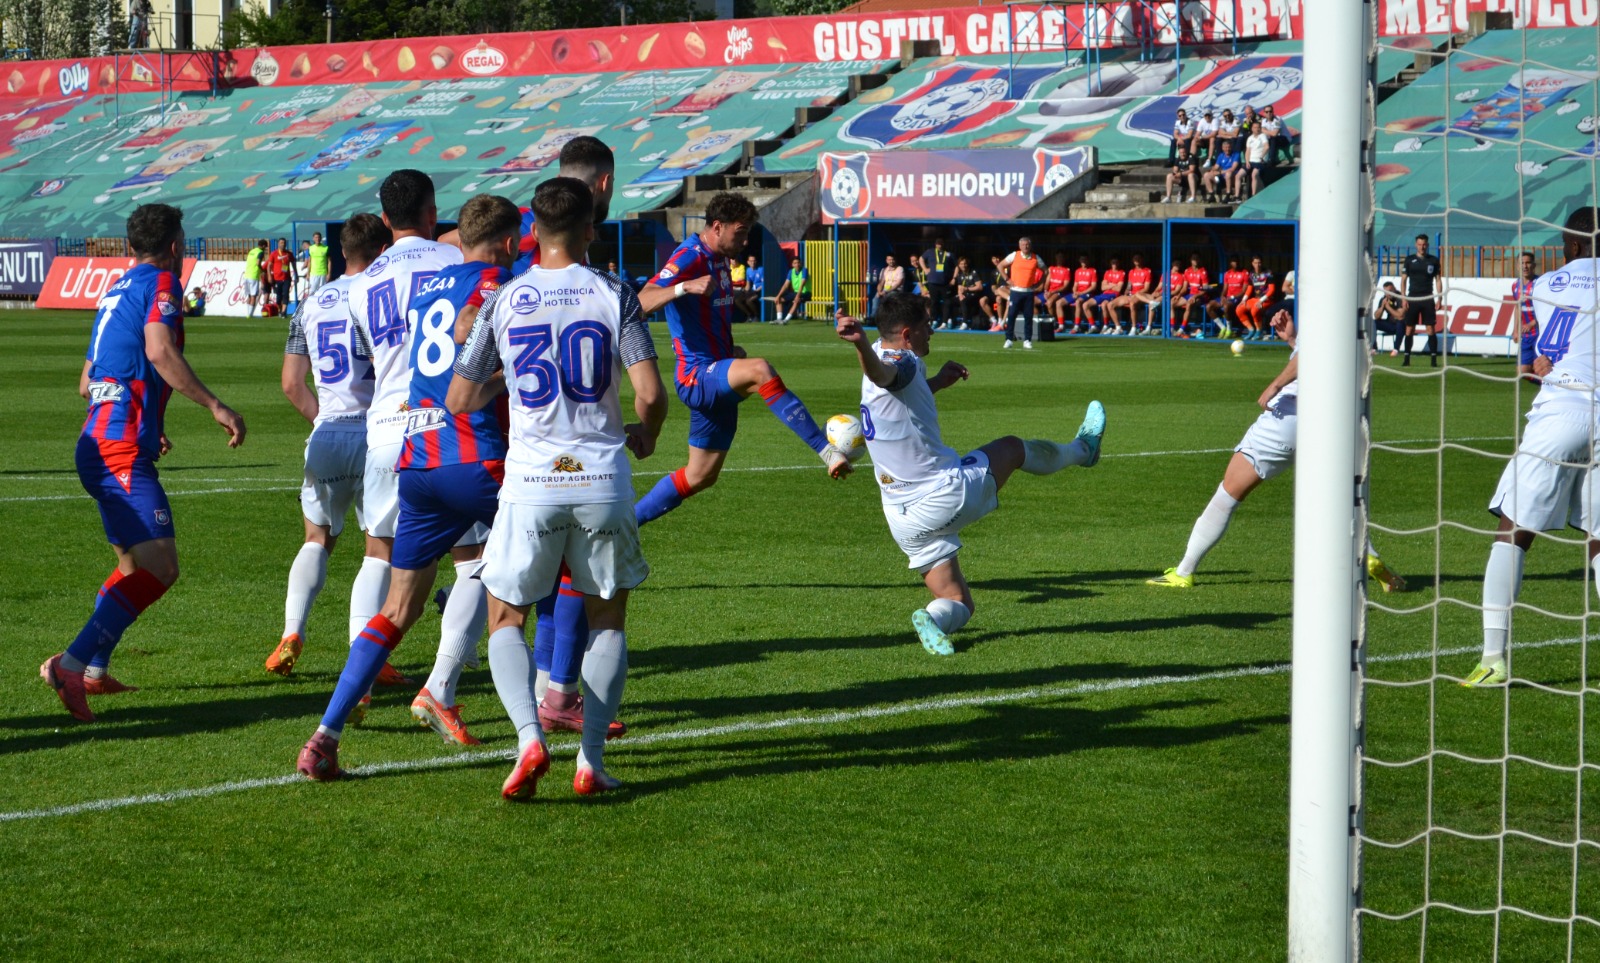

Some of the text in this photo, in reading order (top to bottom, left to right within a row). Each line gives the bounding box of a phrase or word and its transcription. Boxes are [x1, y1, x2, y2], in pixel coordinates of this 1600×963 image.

[726, 25, 748, 44] Viva
[813, 15, 955, 62] GUSTUL
[966, 9, 1064, 54] CARE
[1082, 5, 1138, 47] DA
[1156, 0, 1300, 43] START
[724, 36, 753, 64] Chips
[252, 61, 277, 78] Bakery
[466, 55, 501, 68] REGAL
[58, 61, 90, 96] Olly
[876, 172, 1026, 198] HAI BIHORU'!
[0, 251, 44, 283] NUTI
[391, 253, 422, 265] HOTELS
[543, 287, 595, 298] PHOENICIA
[544, 298, 580, 307] HOTELS
[98, 293, 122, 363] 7
[507, 320, 612, 409] 30
[523, 473, 614, 484] MATGRUP AGREGATE
